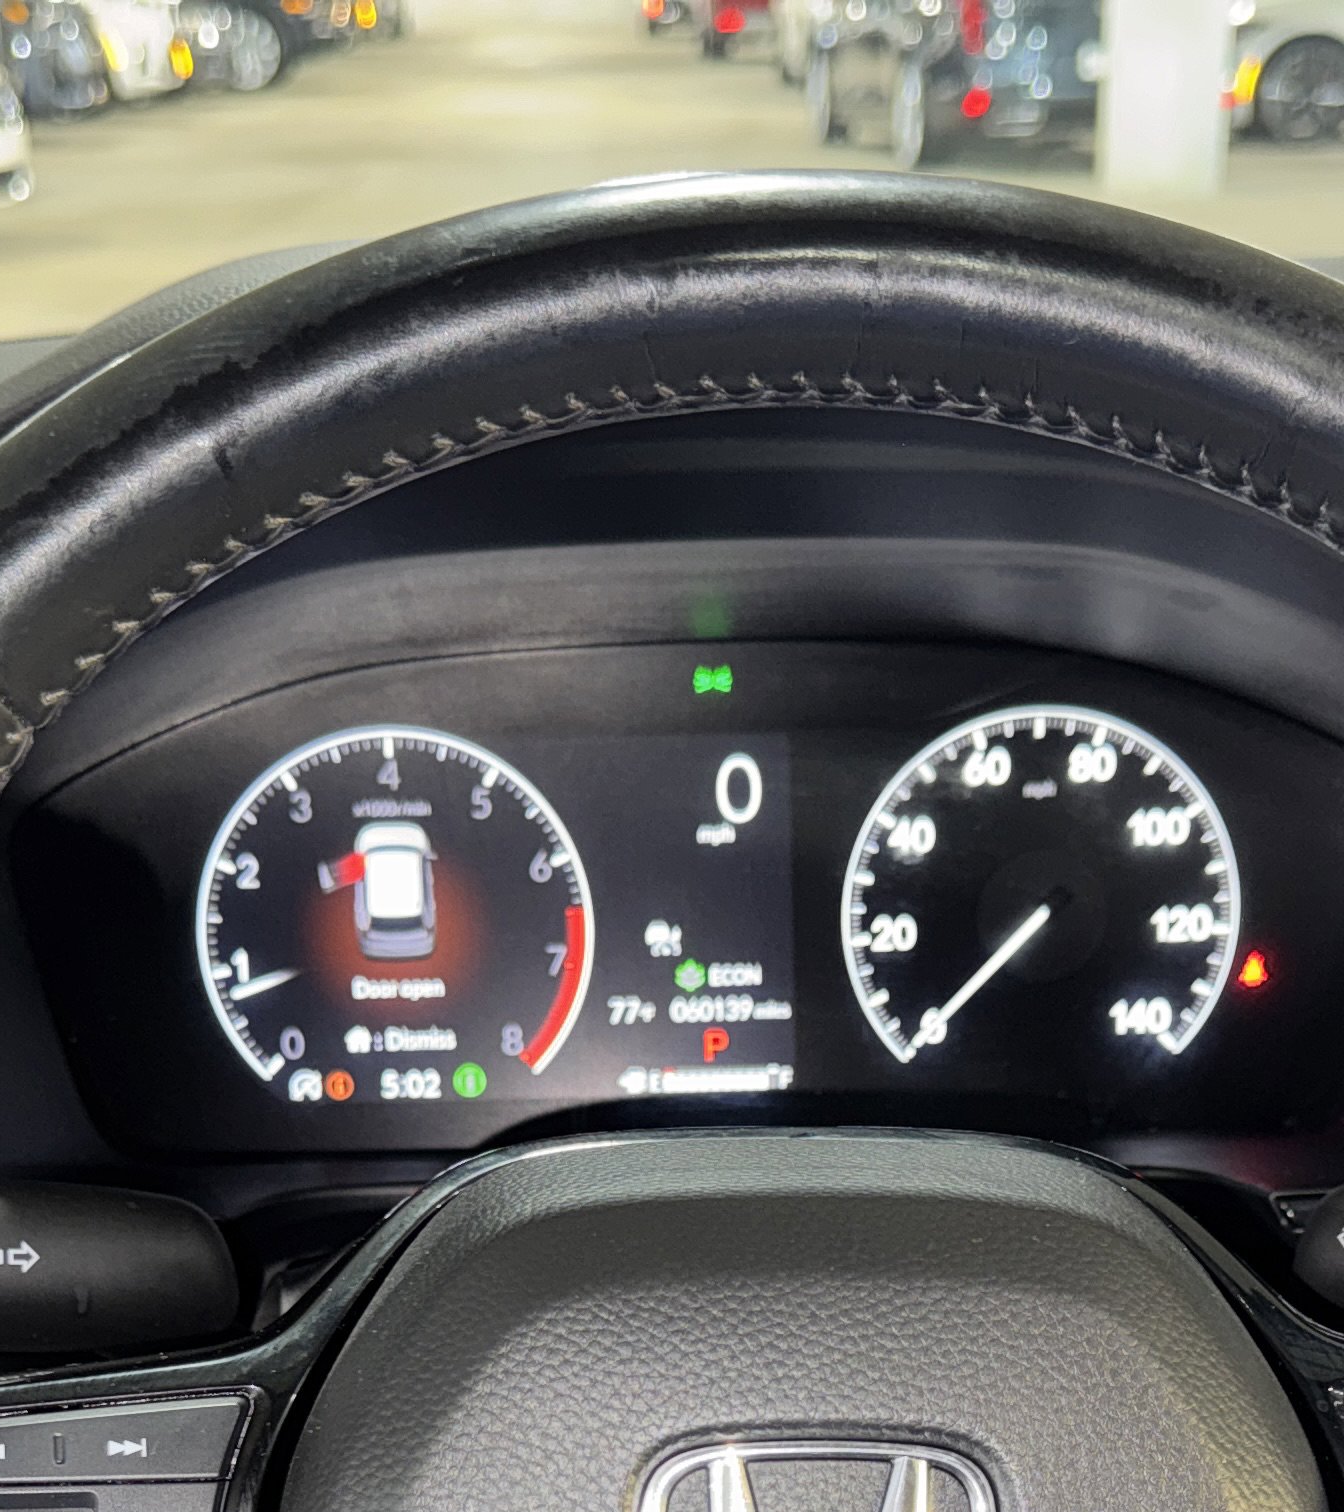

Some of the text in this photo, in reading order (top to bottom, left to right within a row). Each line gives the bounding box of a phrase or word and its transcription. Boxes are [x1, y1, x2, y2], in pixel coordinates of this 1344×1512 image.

[377, 758, 401, 790] 4
[962, 746, 1011, 786] 60
[1068, 742, 1117, 784] 80
[471, 789, 492, 820] 5
[716, 752, 762, 824] 0
[289, 792, 312, 824] 3
[887, 815, 936, 854] 40
[1126, 806, 1191, 847] 100
[236, 853, 260, 890] 2
[529, 851, 552, 883] 6
[870, 913, 918, 952] 20
[1150, 903, 1214, 943] 120
[230, 947, 249, 983] 1
[545, 944, 567, 977] 7
[708, 962, 762, 987] ECON
[1109, 996, 1172, 1036] 140
[280, 1027, 305, 1060] 0
[502, 1023, 523, 1056] 8
[703, 1027, 729, 1062] P
[380, 1068, 441, 1099] 5:02
